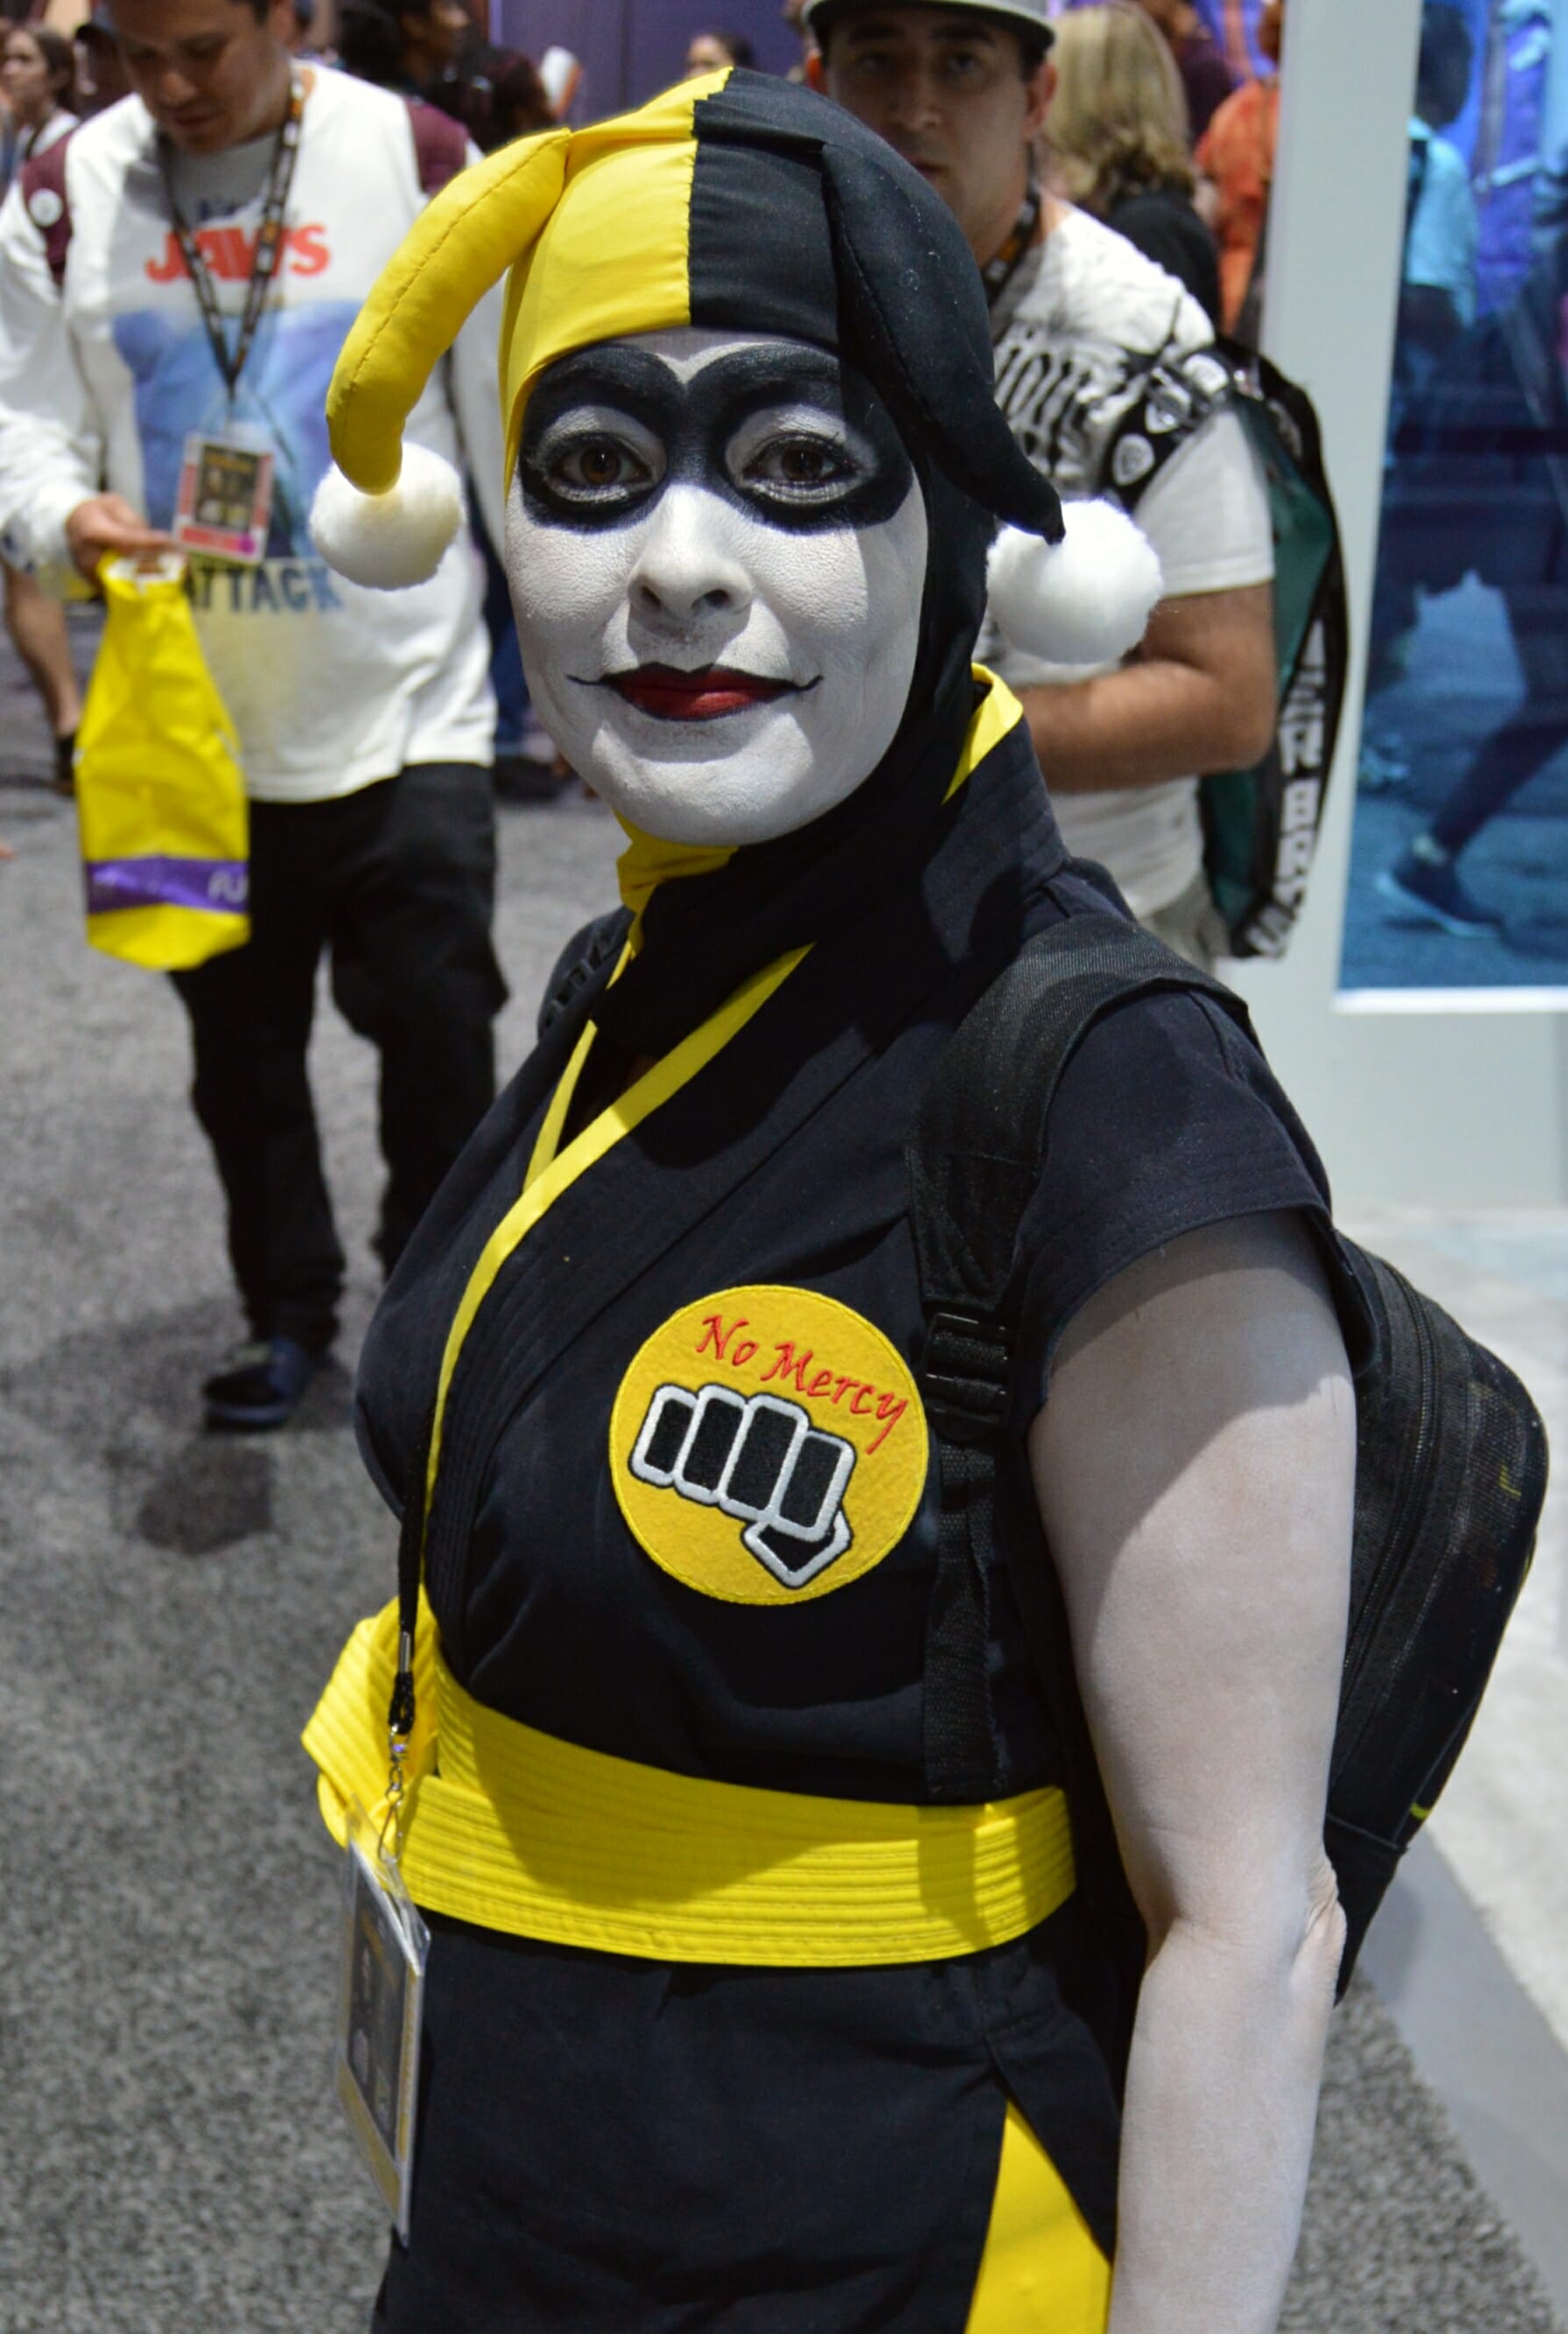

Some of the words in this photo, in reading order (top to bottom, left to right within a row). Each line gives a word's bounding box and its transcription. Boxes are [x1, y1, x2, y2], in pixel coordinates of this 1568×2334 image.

[145, 224, 330, 284] JAWS
[696, 1315, 759, 1366] No
[760, 1341, 908, 1455] Mercy
